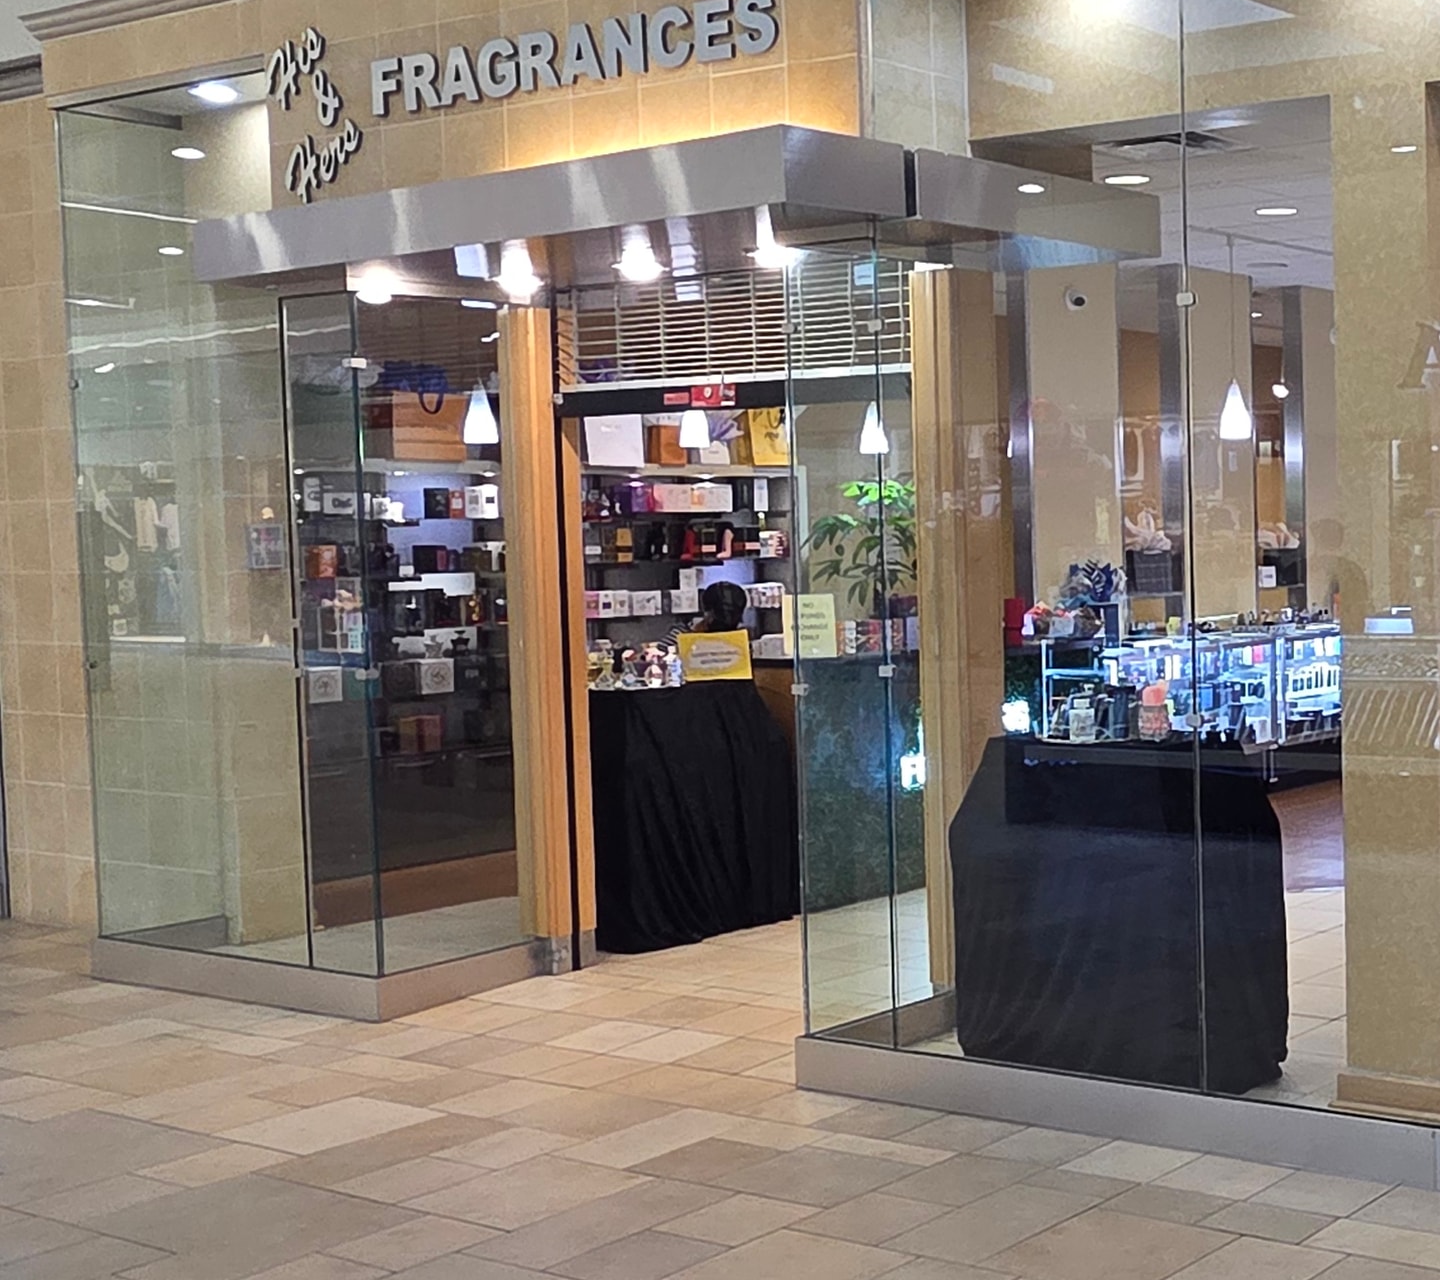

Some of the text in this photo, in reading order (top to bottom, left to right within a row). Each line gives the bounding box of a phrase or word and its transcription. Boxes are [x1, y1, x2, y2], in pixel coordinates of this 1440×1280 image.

[266, 26, 325, 111] His
[312, 69, 343, 127] &
[285, 118, 363, 204] Hers
